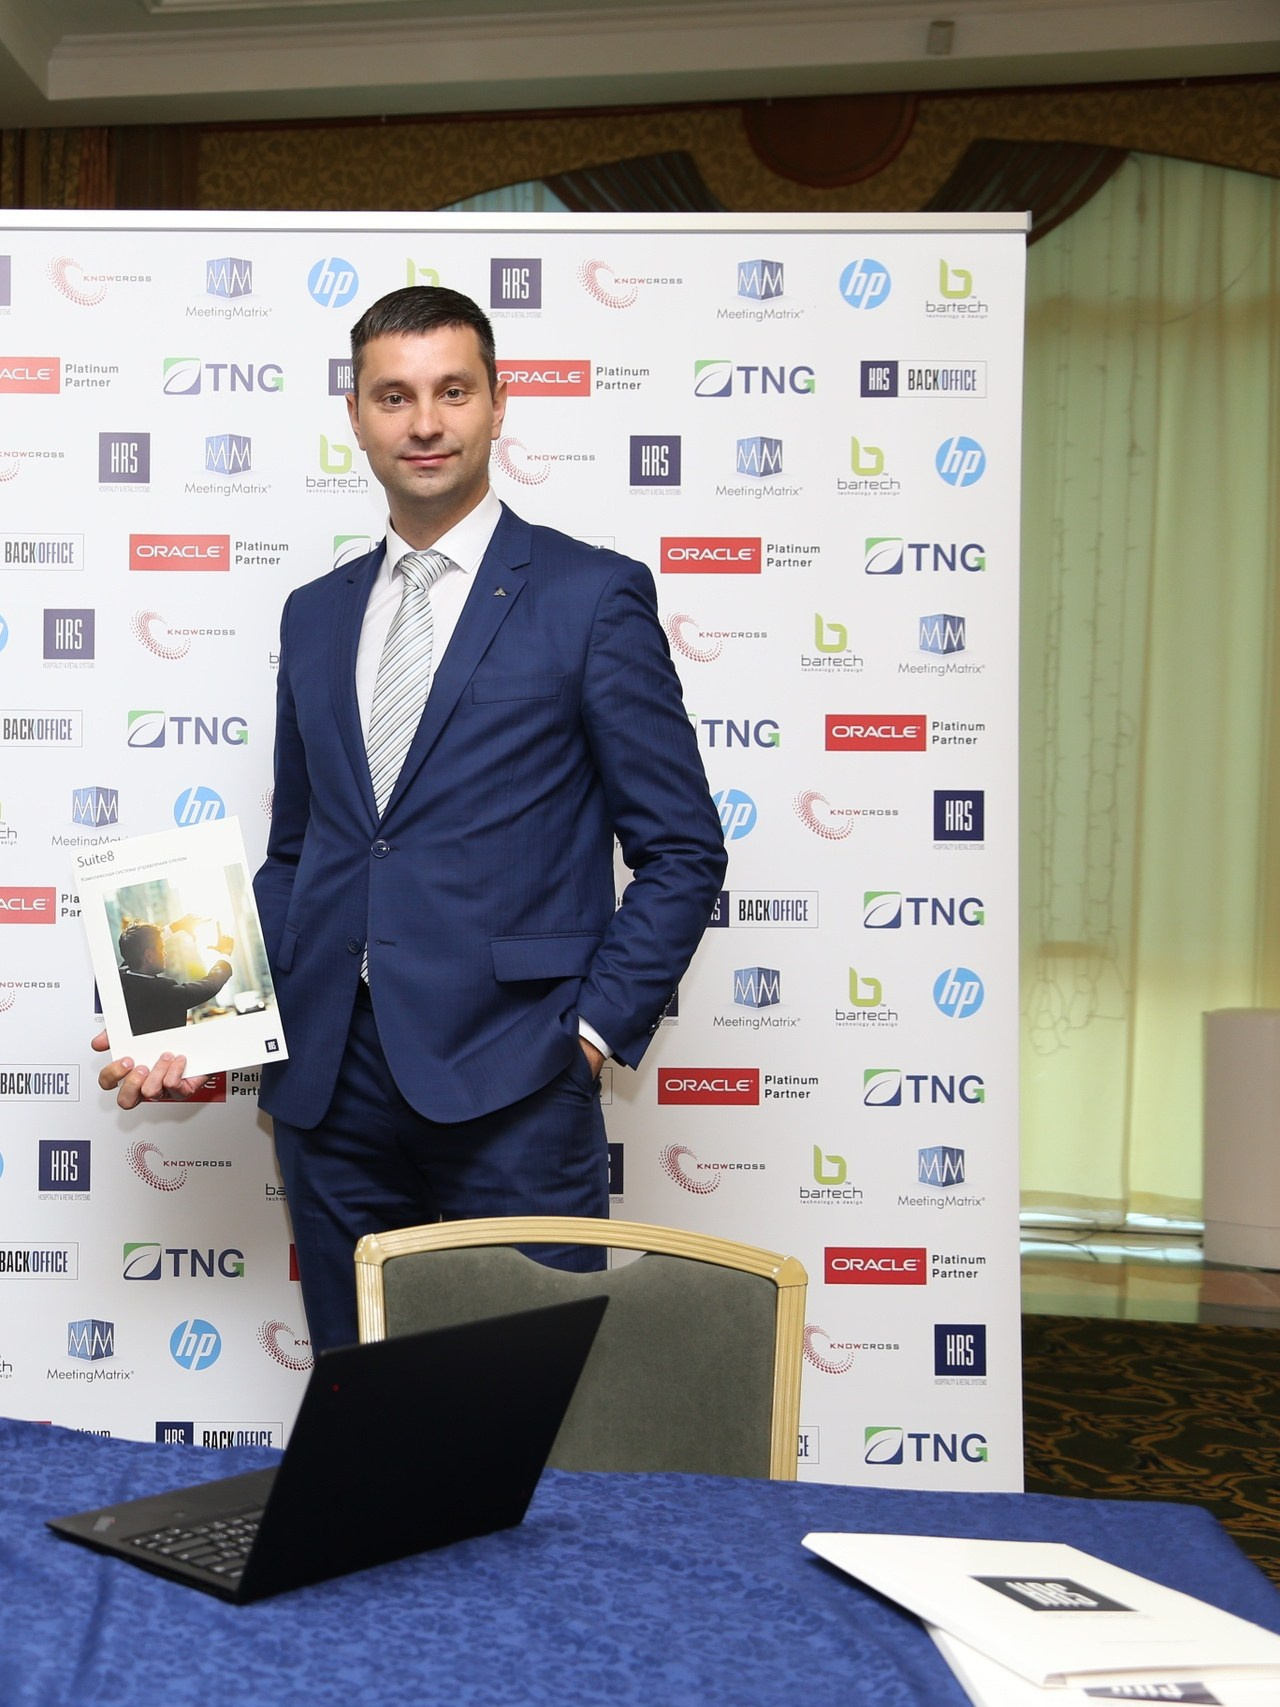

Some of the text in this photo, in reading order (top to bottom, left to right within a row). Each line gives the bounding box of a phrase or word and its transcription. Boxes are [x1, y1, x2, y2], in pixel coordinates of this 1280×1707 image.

[314, 258, 352, 307] hp
[503, 268, 529, 299] HRS
[845, 259, 884, 309] hp
[926, 301, 988, 313] bartech
[66, 364, 118, 373] Platinum
[596, 367, 649, 376] Platinum
[66, 378, 111, 387] Partner
[205, 364, 283, 392] TNG
[498, 371, 582, 383] ORACLE
[737, 366, 814, 394] TNG
[869, 368, 890, 390] HRS
[596, 381, 641, 390] Partner
[111, 443, 137, 473] HRS
[642, 445, 669, 476] HRS
[942, 437, 981, 486] hp
[306, 476, 368, 487] bartech
[837, 478, 900, 490] bartech
[137, 546, 220, 557] ORACLE
[236, 542, 288, 551] Platinum
[767, 544, 820, 553] Platinum
[236, 555, 280, 564] Partner
[667, 548, 753, 560] ORACLE
[908, 544, 985, 572] TNG
[767, 558, 812, 567] Partner
[56, 619, 82, 649] HRS
[801, 655, 863, 666] bartech
[169, 717, 248, 745] TNG
[832, 726, 918, 738] ORACLE
[932, 722, 985, 731] Platinum
[701, 720, 779, 748] TNG
[932, 735, 977, 744] Partner
[181, 787, 220, 826] hp
[721, 790, 751, 839] hp
[945, 800, 972, 831] HRS
[77, 851, 114, 867] Suite8
[906, 898, 984, 926] TNG
[939, 968, 978, 1018] hp
[836, 1009, 898, 1021] bartech
[665, 1080, 751, 1091] ORACLE
[765, 1075, 818, 1084] Platinum
[765, 1089, 810, 1098] Partner
[906, 1075, 984, 1104] TNG
[52, 1151, 78, 1181] HRS
[800, 1187, 863, 1198] bartech
[166, 1249, 244, 1278] TNG
[832, 1259, 919, 1271] ORACLE
[932, 1255, 986, 1264] Platinum
[933, 1269, 978, 1278] Partner
[175, 1319, 216, 1370] hp
[947, 1335, 974, 1366] HRS
[908, 1433, 987, 1462] TNG
